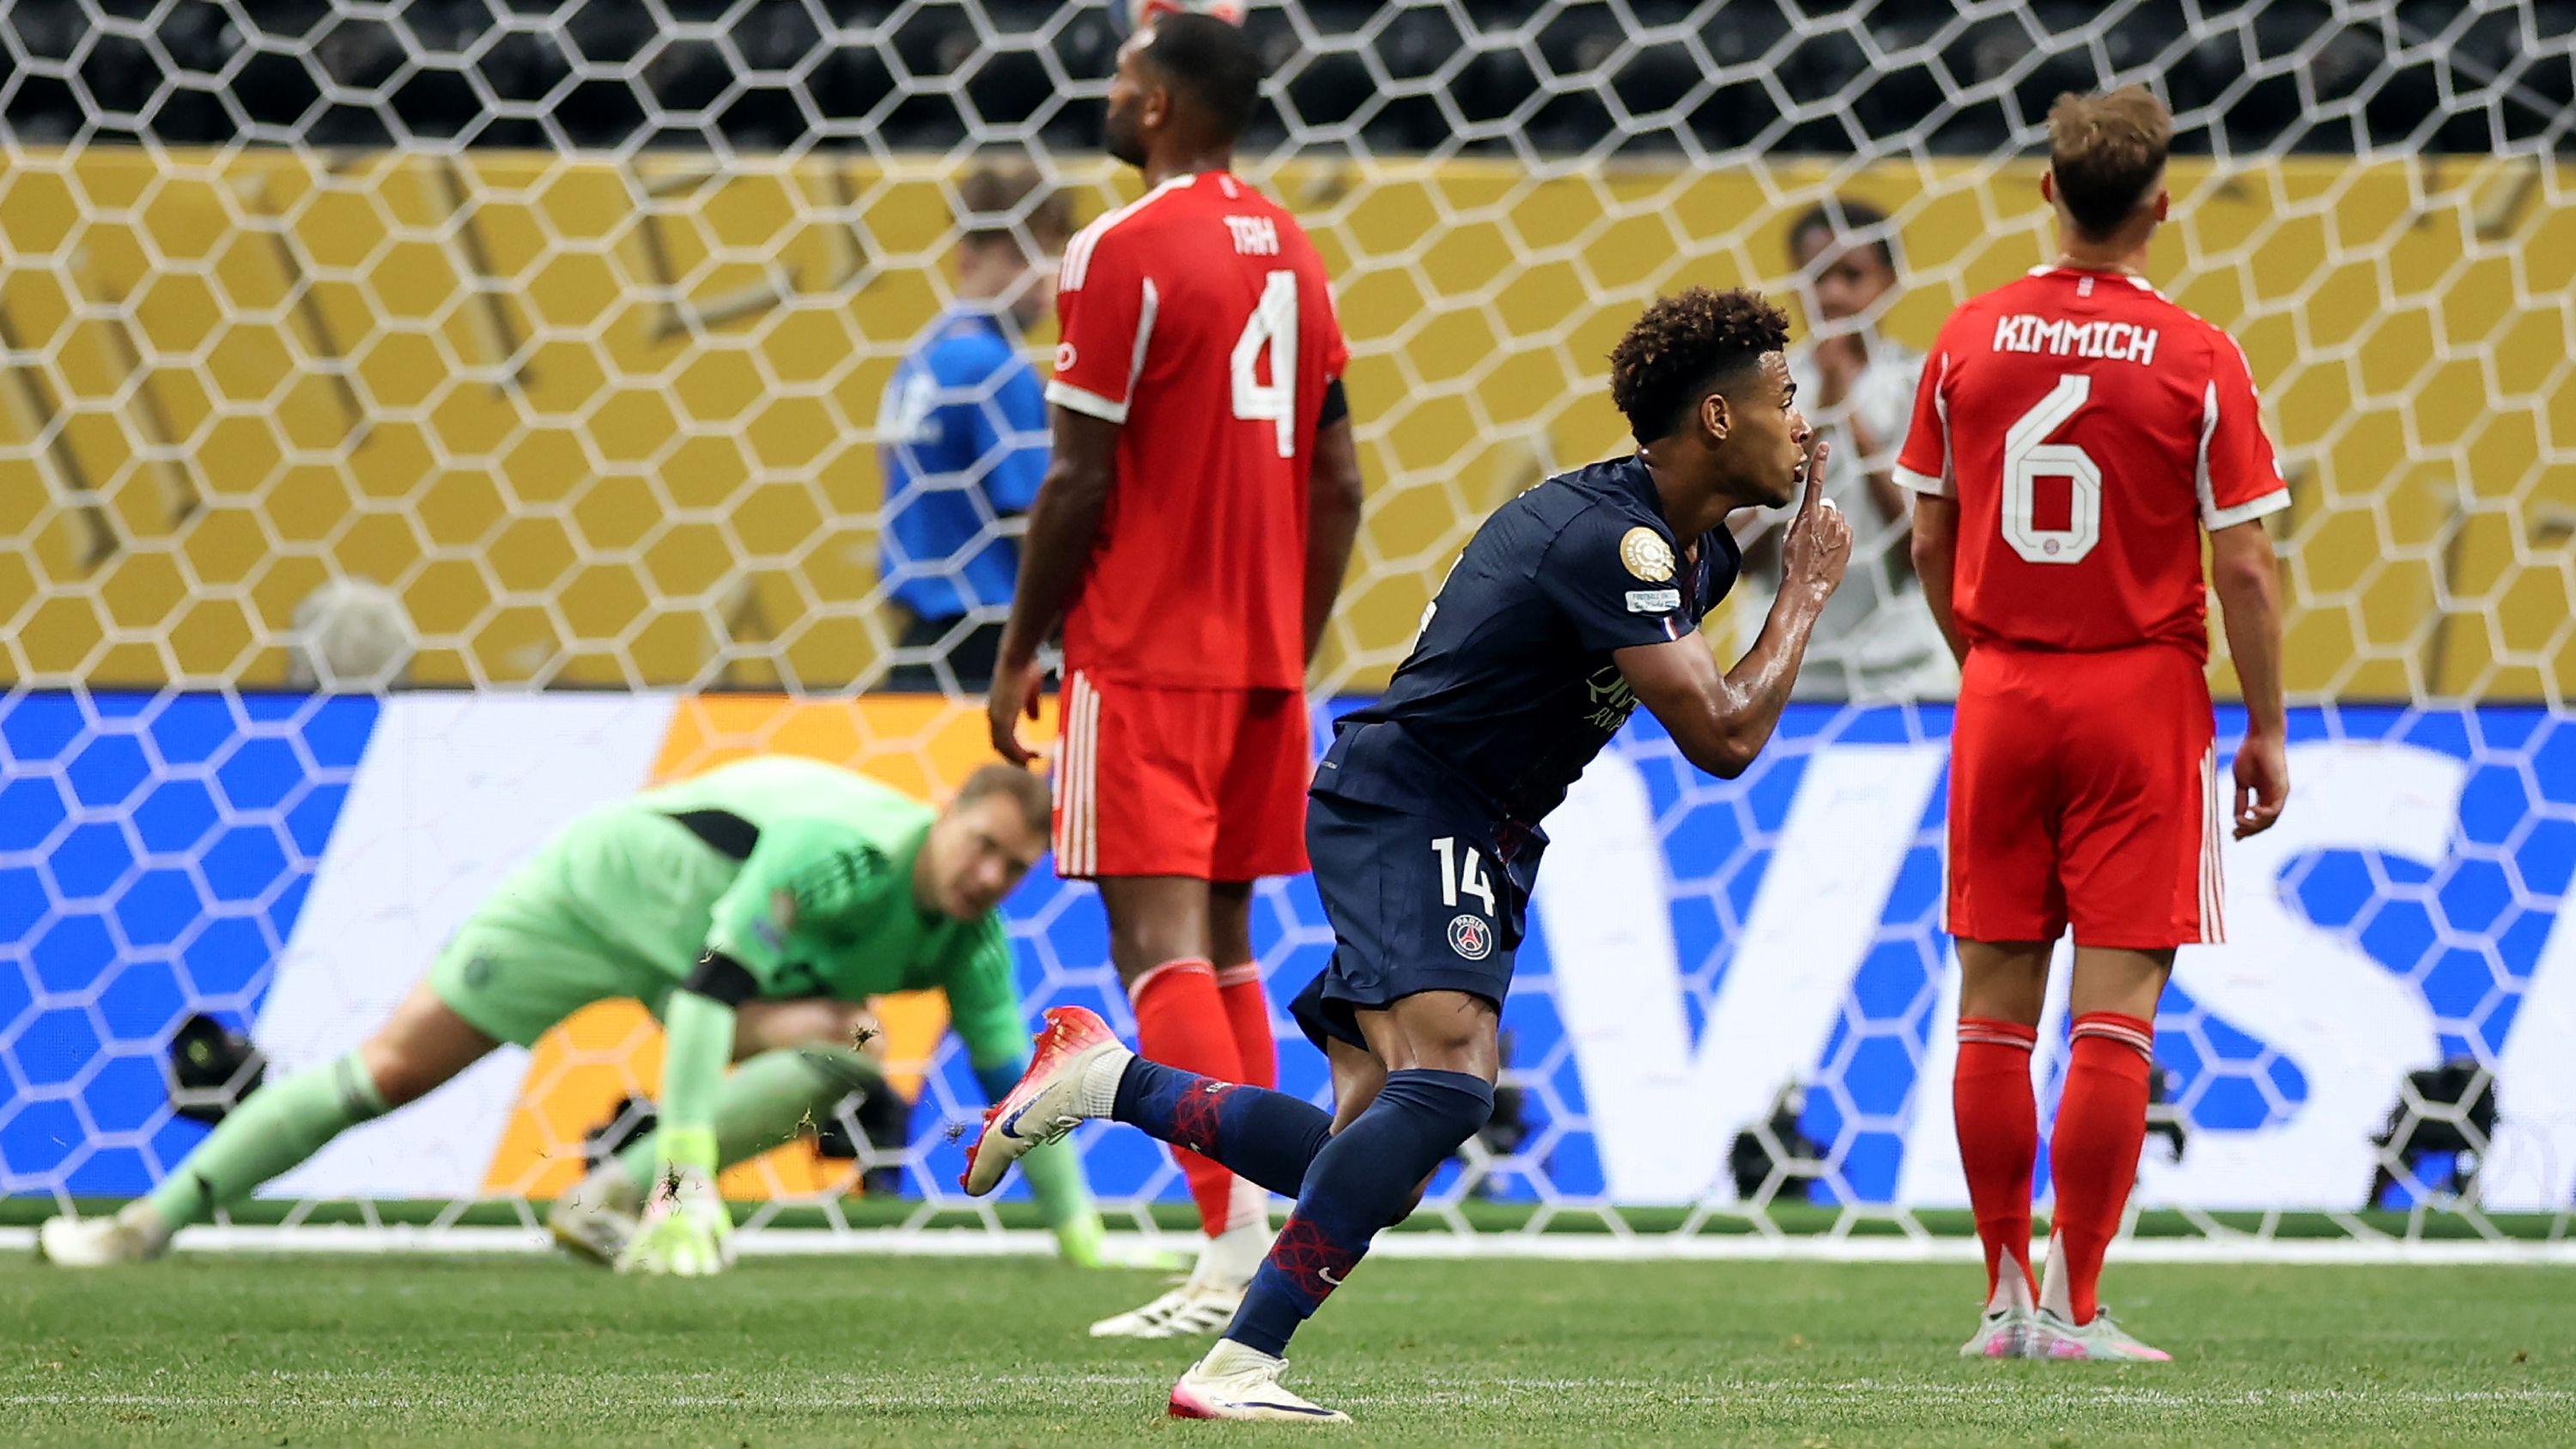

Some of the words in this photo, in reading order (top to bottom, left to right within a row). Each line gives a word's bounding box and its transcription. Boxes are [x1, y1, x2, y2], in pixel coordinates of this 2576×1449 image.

[1223, 215, 1280, 256] TAH
[1230, 269, 1298, 458] 4
[1992, 313, 2160, 367] KIMMICH
[2001, 373, 2102, 565] 6
[1431, 836, 1496, 918] 14
[1455, 916, 1486, 932] PARIS
[1533, 739, 2576, 1211] VS
